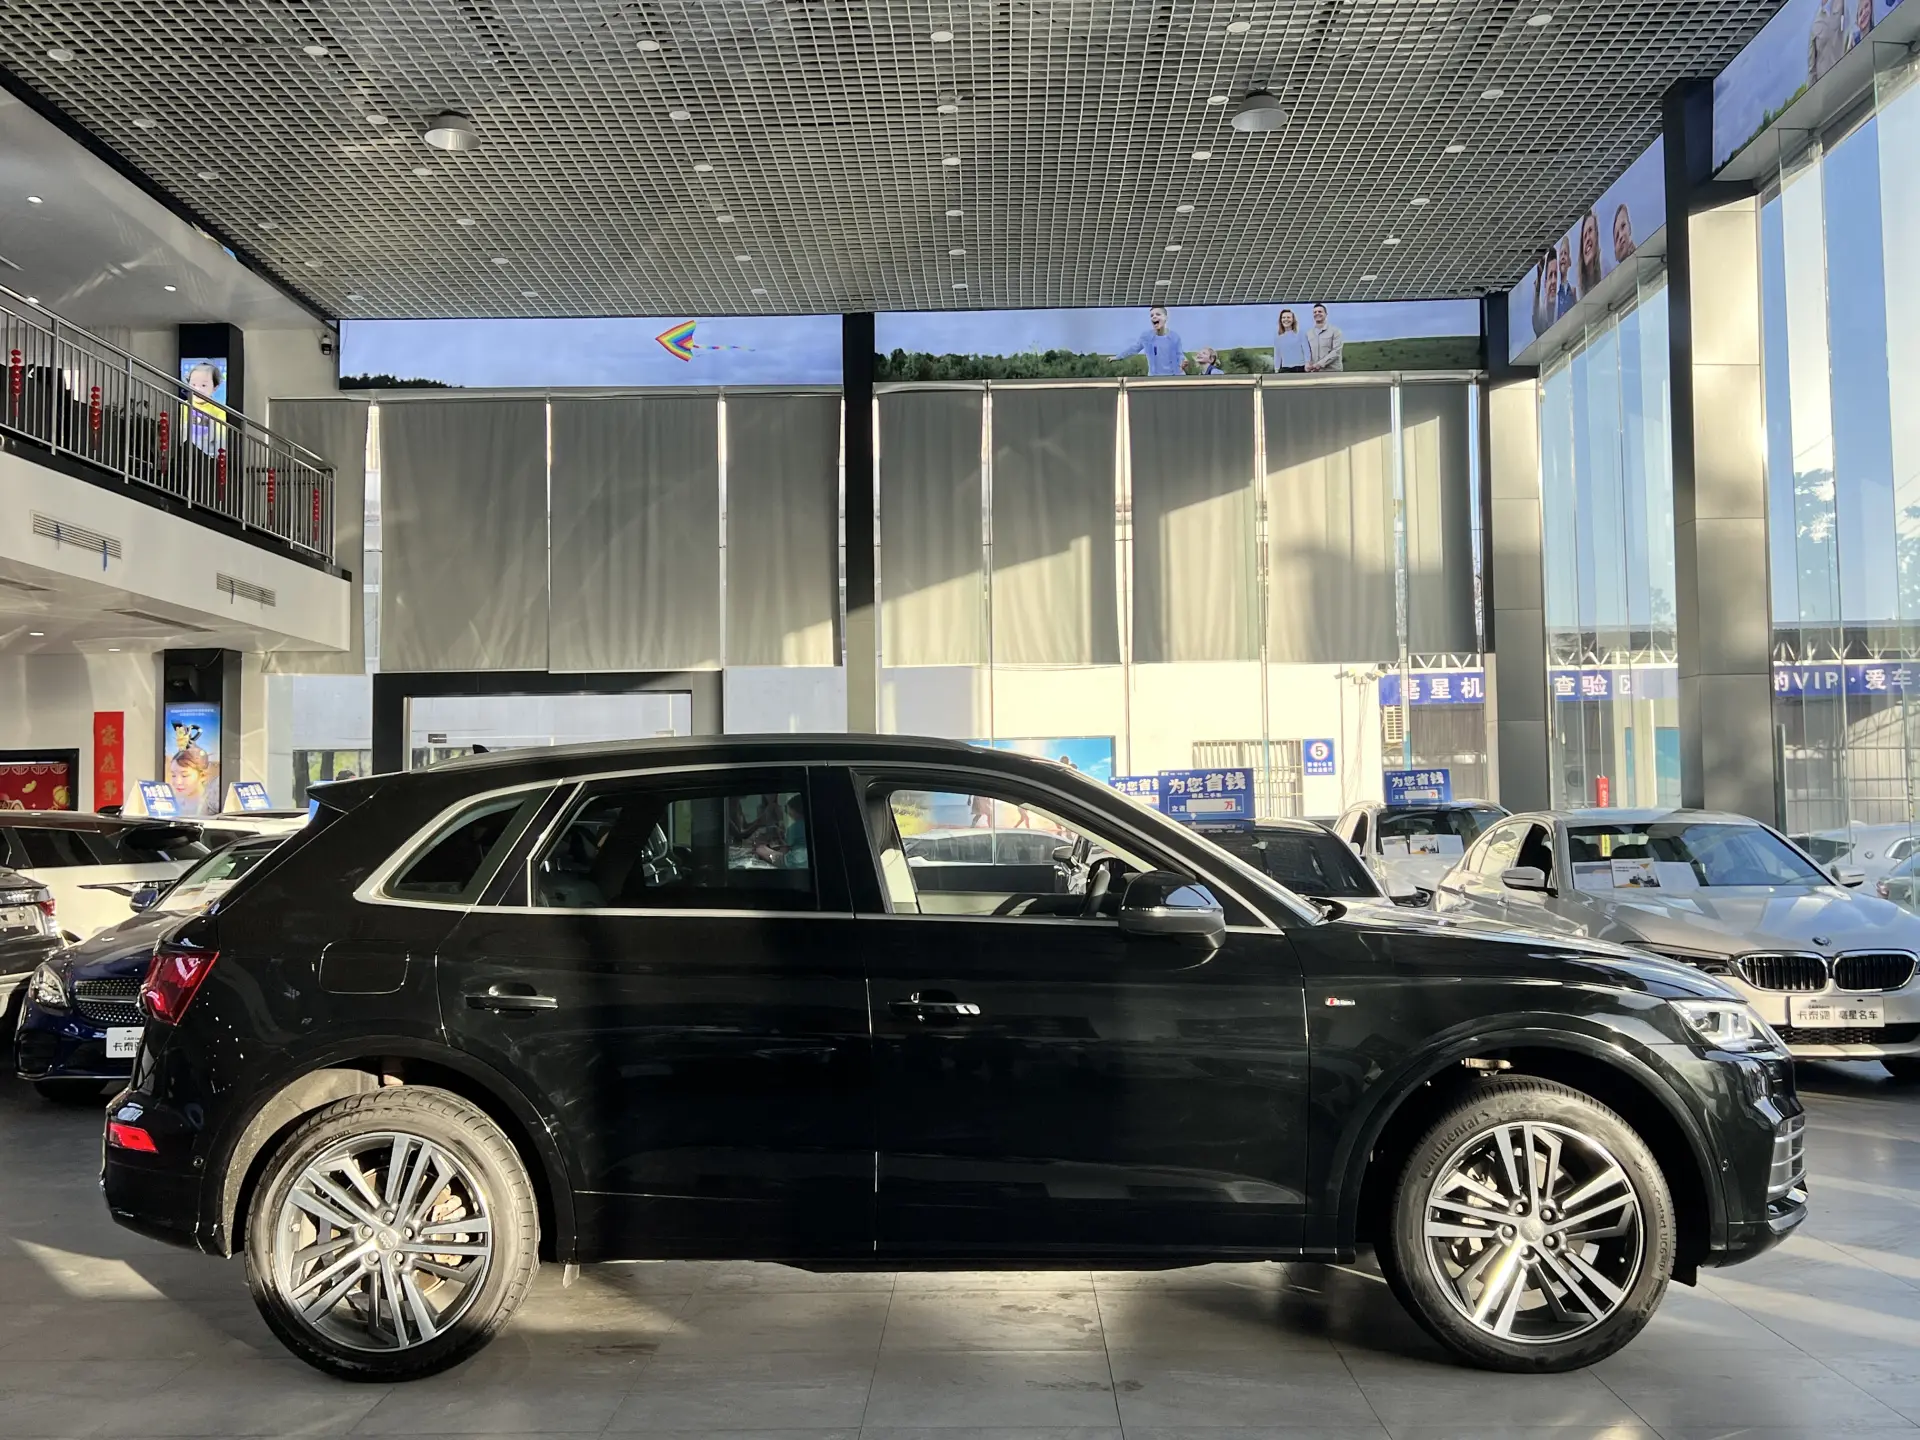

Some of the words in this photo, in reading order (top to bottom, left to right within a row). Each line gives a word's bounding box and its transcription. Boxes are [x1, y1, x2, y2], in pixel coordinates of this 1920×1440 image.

[1315, 745, 1324, 757] 5
[1168, 771, 1246, 795] 为您省钱
[1391, 771, 1444, 788] 为您省钱
[1224, 800, 1234, 811] 万
